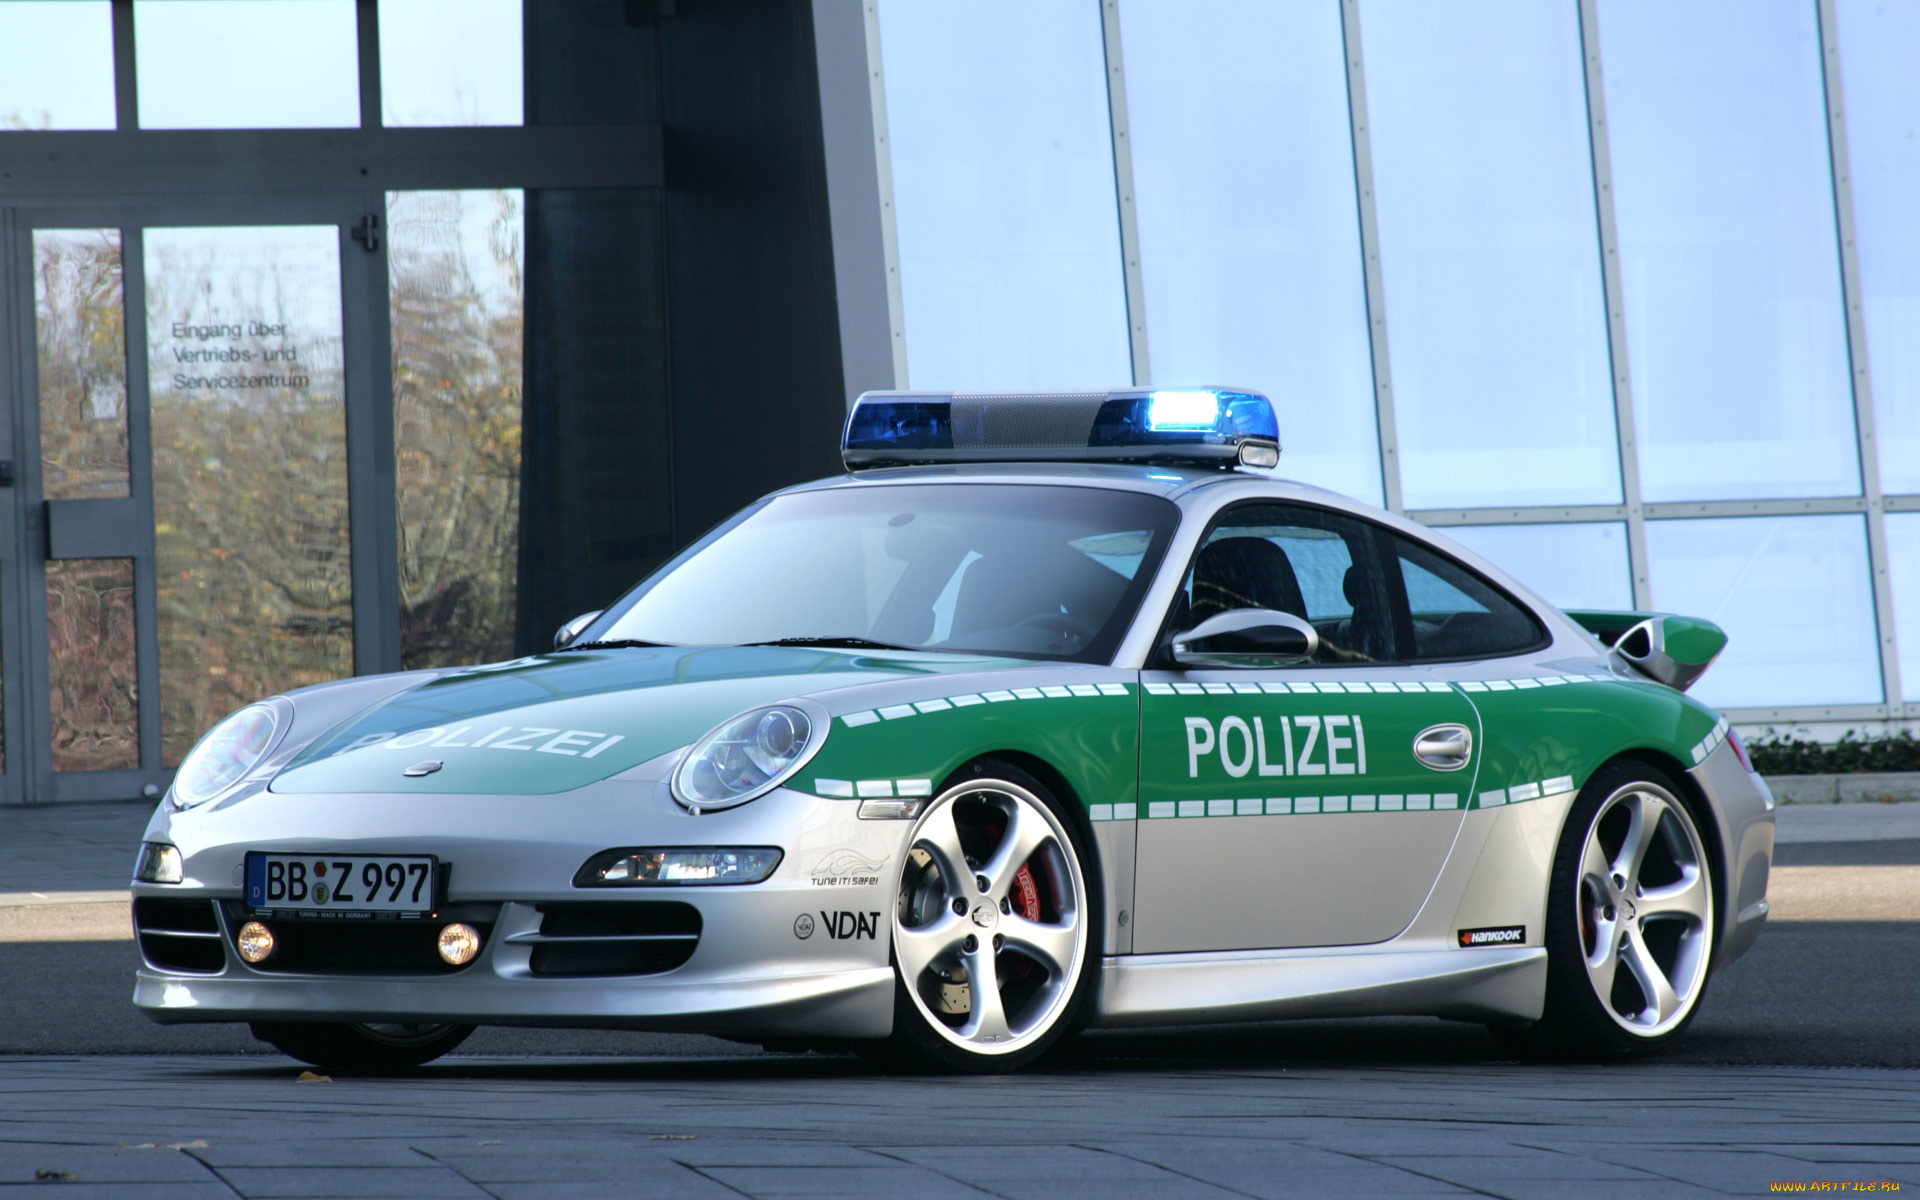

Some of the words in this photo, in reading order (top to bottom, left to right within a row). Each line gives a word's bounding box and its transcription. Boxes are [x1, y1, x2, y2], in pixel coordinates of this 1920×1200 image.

[172, 322, 242, 341] Eingang
[248, 321, 287, 338] über
[173, 347, 259, 363] Vertriebs-
[264, 346, 297, 362] und
[174, 373, 309, 390] Servicezentrum
[331, 726, 626, 759] POLIZEI
[1184, 715, 1367, 778] POLIZEI
[253, 886, 260, 898] D
[267, 861, 308, 902] BB
[332, 862, 354, 902] Z
[362, 863, 429, 903] 997
[820, 911, 881, 940] VDAT
